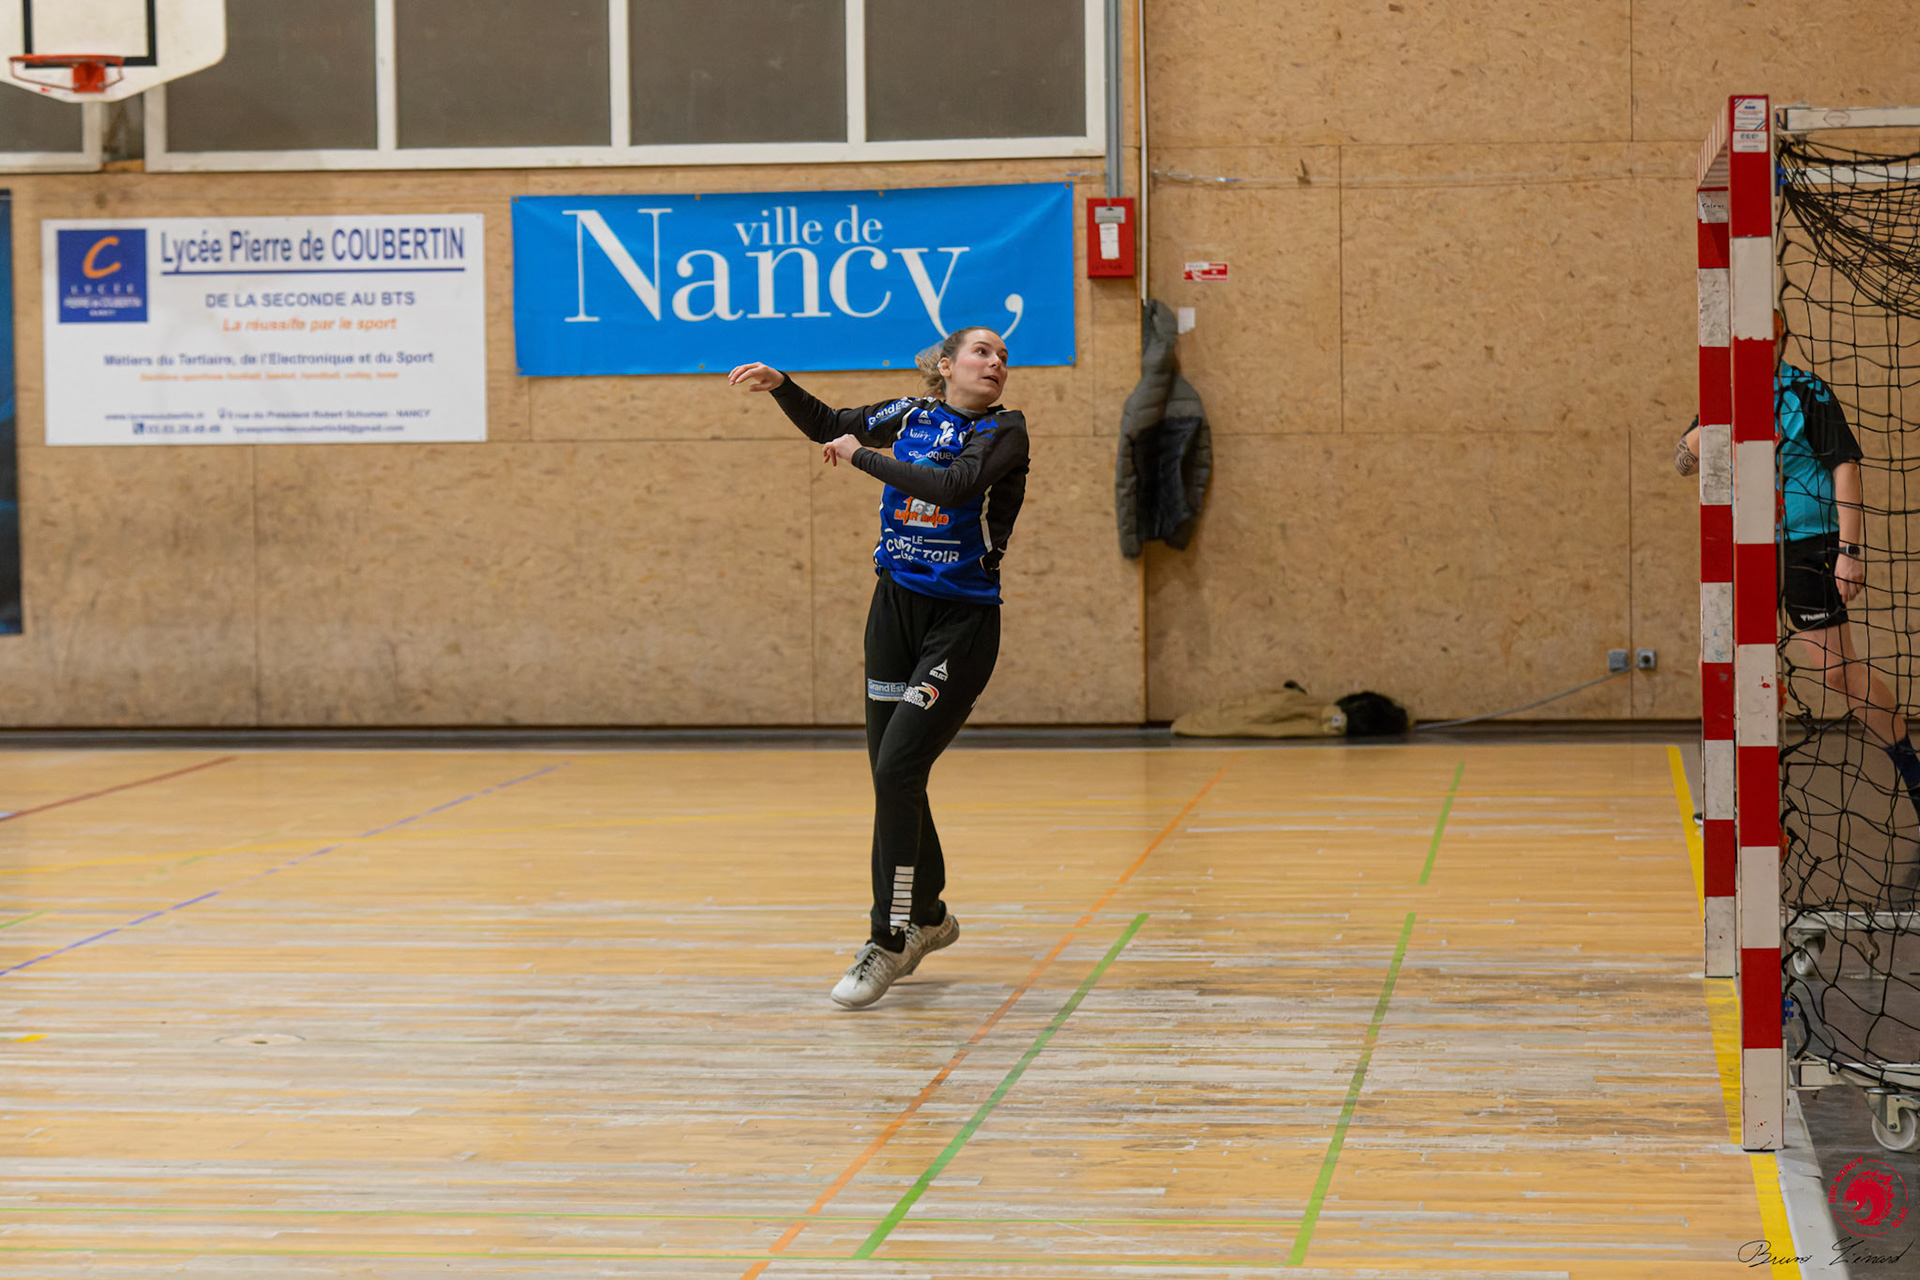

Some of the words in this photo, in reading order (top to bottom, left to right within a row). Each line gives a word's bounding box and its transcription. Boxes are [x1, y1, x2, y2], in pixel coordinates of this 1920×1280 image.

[733, 206, 823, 247] ville
[834, 204, 883, 244] de
[161, 230, 222, 272] Lycée
[229, 230, 292, 263] Pierre
[299, 230, 324, 262] de
[331, 227, 465, 261] COUBERTIN
[206, 293, 228, 307] DE
[234, 293, 257, 307] LA
[261, 292, 346, 307] SECONDE
[350, 292, 375, 306] AU
[381, 291, 416, 306] BTS
[222, 319, 241, 332] La
[310, 318, 335, 334] par
[339, 317, 352, 330] le
[356, 317, 397, 333] sport
[157, 354, 174, 365] du
[240, 353, 256, 365] de
[358, 352, 371, 363] et
[375, 351, 393, 364] du
[396, 351, 433, 365] Sport
[911, 535, 923, 545] LE
[928, 669, 948, 682] SELECT
